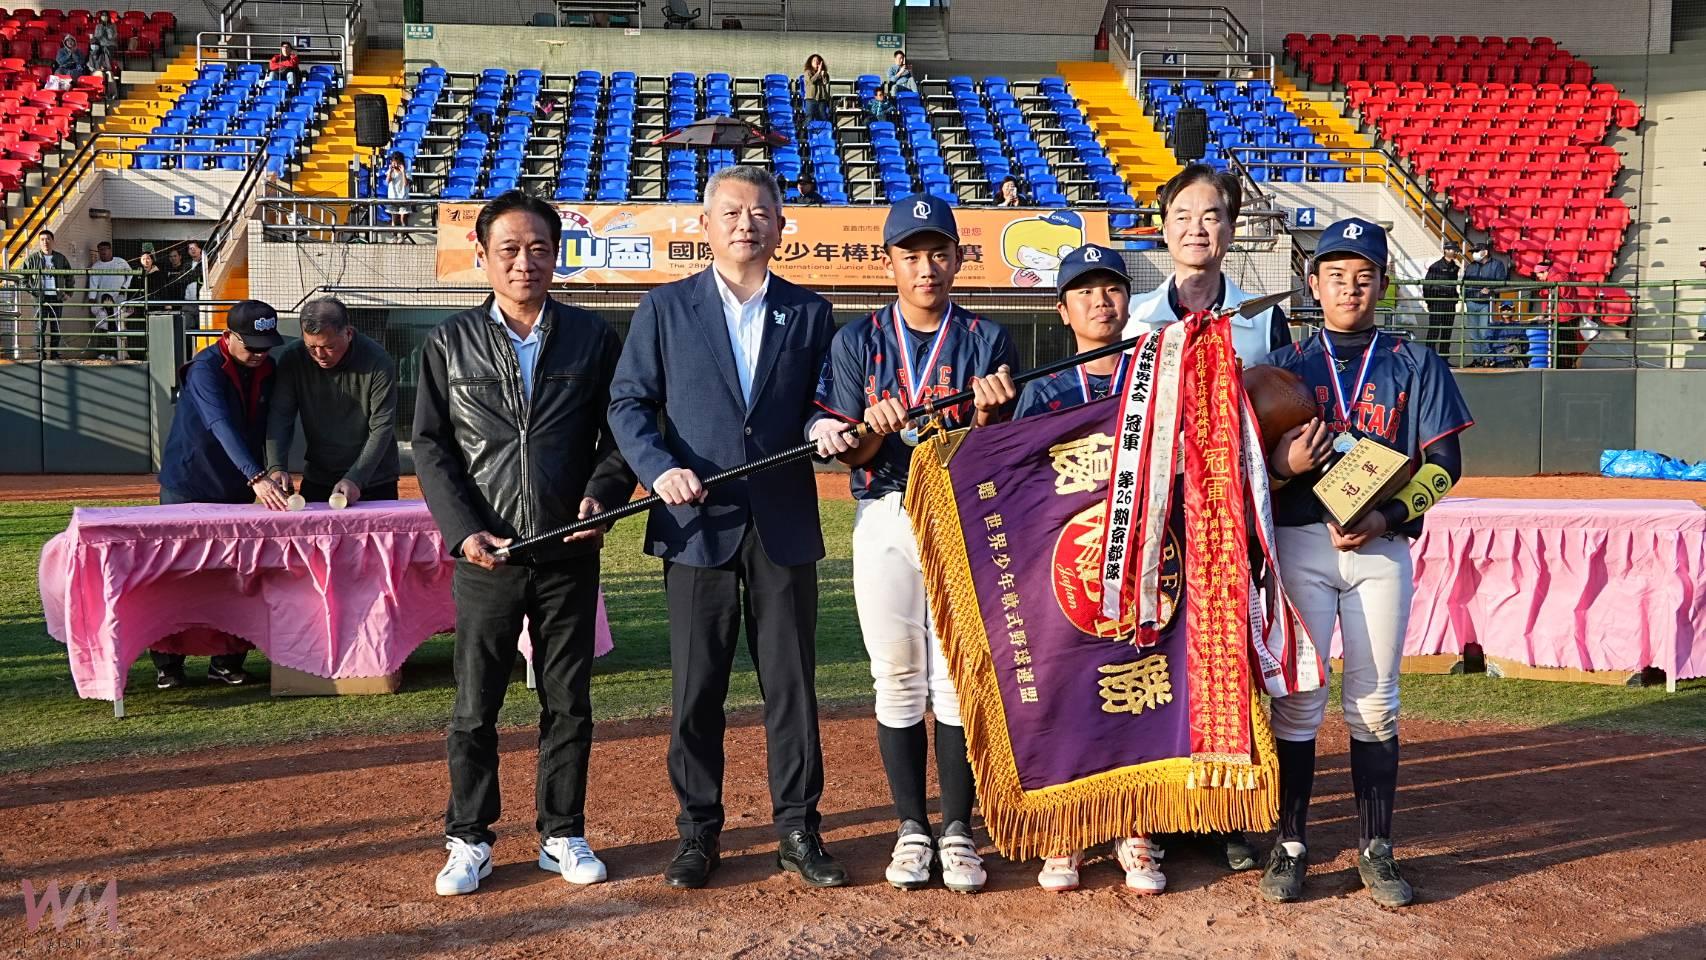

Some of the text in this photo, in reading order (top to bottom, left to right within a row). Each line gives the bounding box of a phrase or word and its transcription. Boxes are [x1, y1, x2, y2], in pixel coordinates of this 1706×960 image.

[1165, 54, 1175, 64] 4
[146, 101, 159, 109] 11
[131, 117, 147, 125] 10
[178, 198, 191, 213] 5
[558, 212, 581, 222] 025
[1299, 210, 1311, 225] 4
[1122, 414, 1143, 452] 冠軍
[1202, 447, 1232, 508] 冠軍
[1056, 562, 1078, 610] Japan
[1097, 654, 1174, 715] 勝
